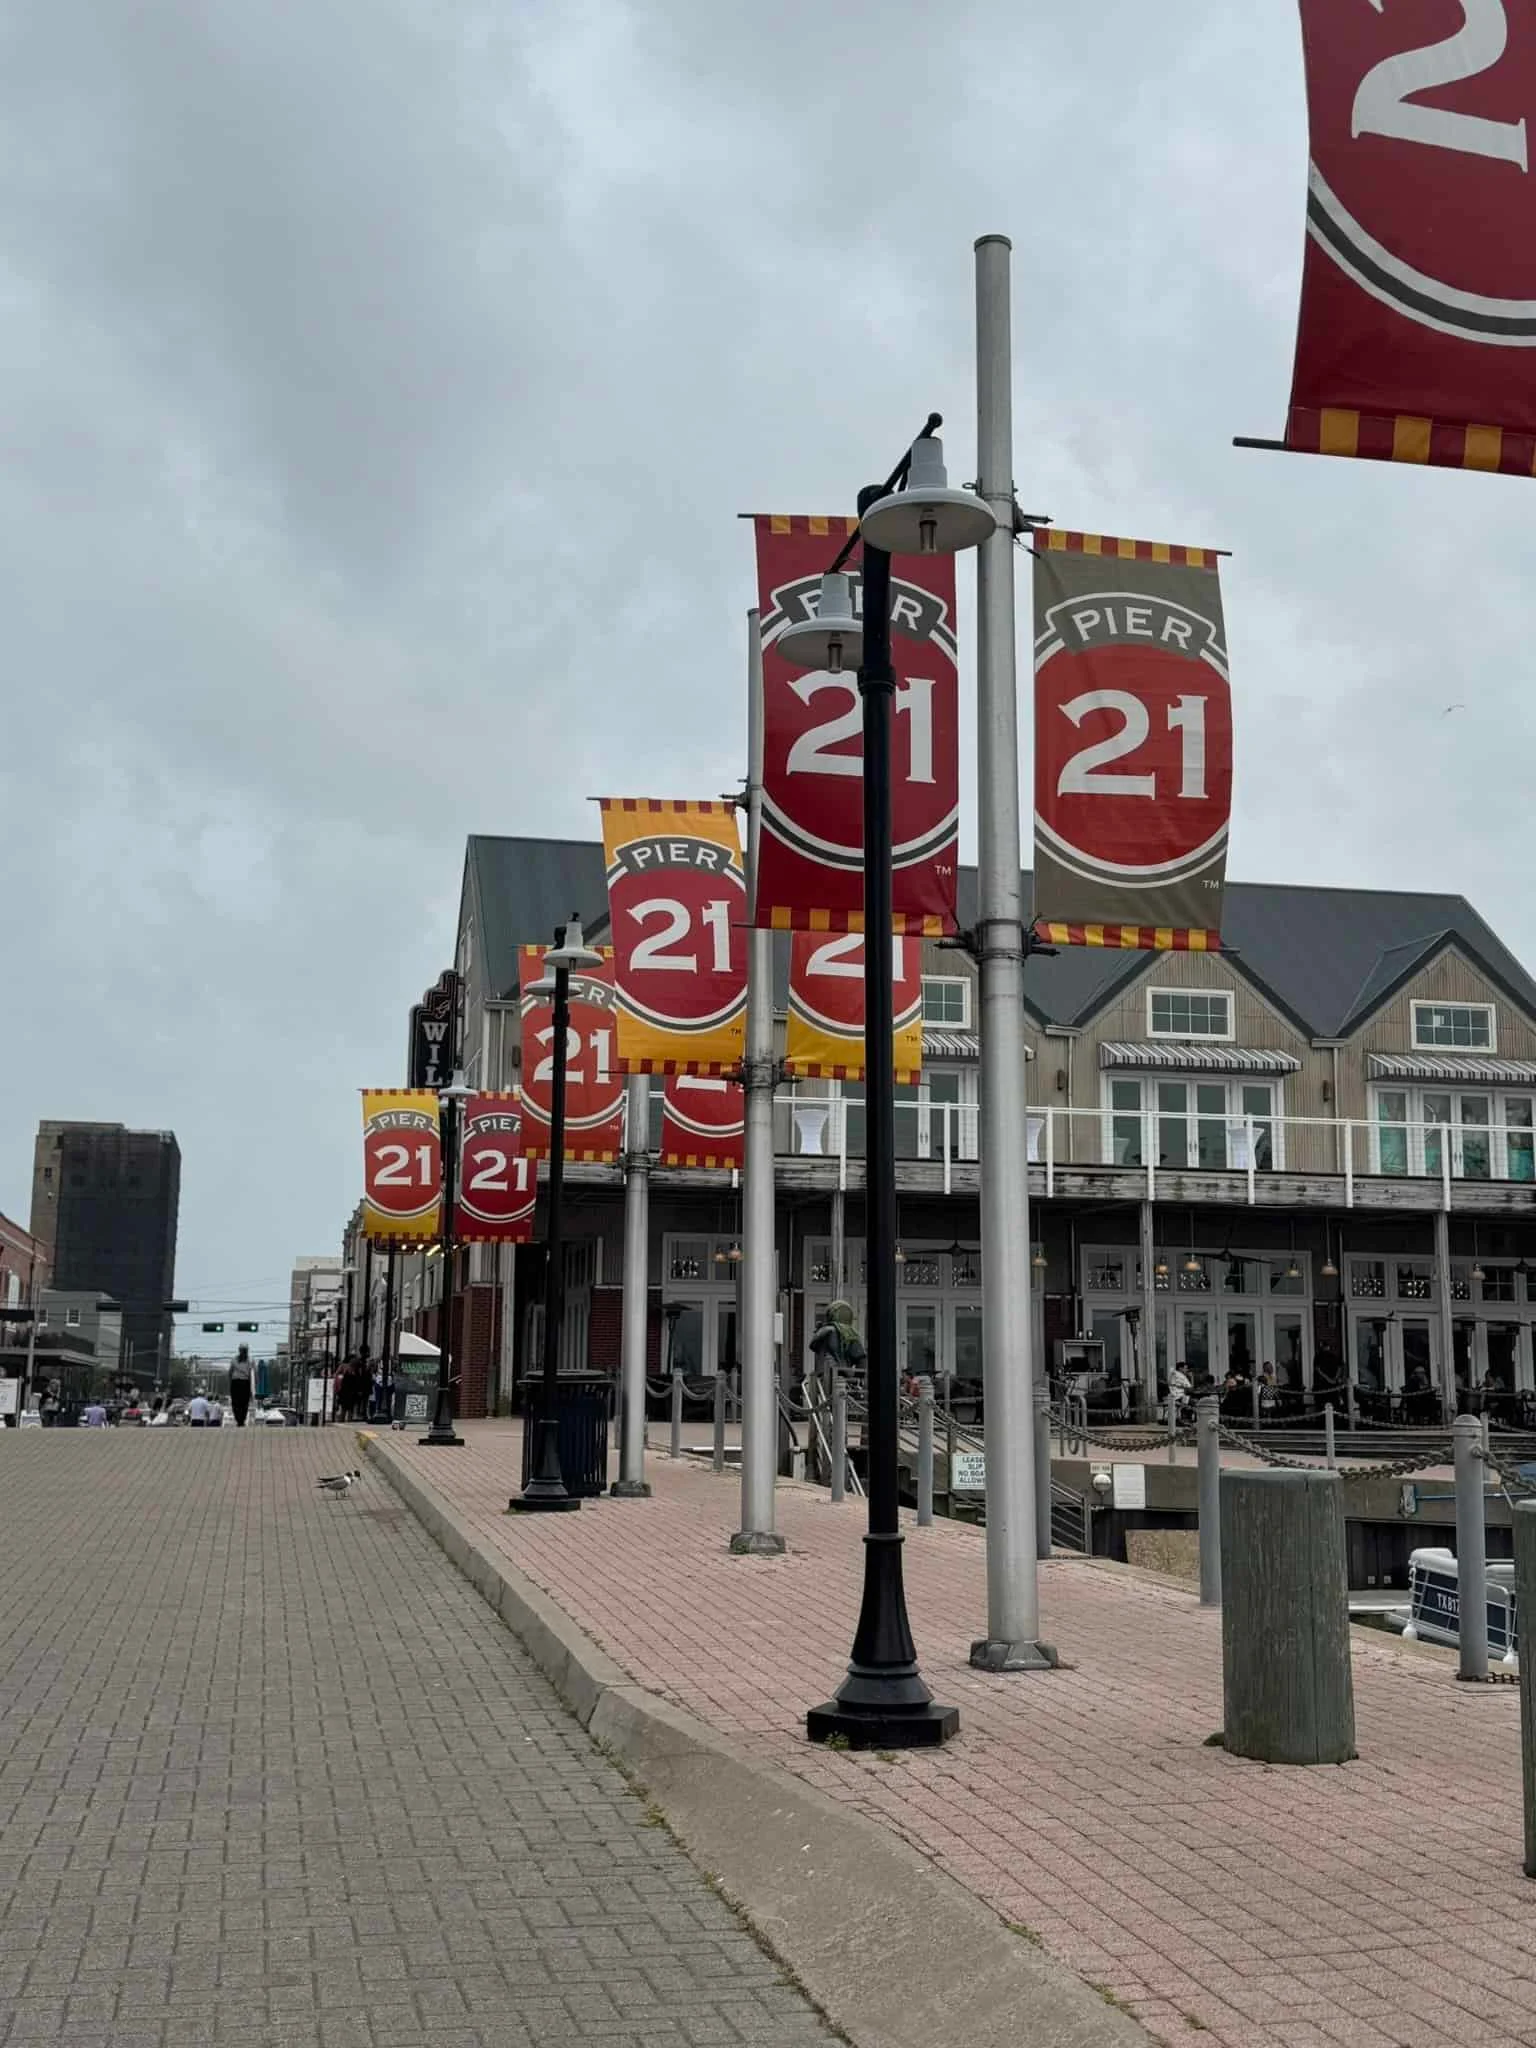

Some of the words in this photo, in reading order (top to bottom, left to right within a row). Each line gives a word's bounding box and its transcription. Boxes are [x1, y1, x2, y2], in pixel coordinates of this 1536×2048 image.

[1072, 606, 1193, 650] PIER
[786, 670, 937, 783] 21
[1057, 689, 1209, 801] 21
[631, 843, 719, 870] PIER
[935, 865, 951, 876] TM
[1203, 880, 1220, 889] TM
[626, 898, 733, 975] 21
[533, 1026, 612, 1084] 21
[378, 1113, 426, 1129] PIER
[373, 1144, 433, 1187] 21
[470, 1150, 529, 1192] 21
